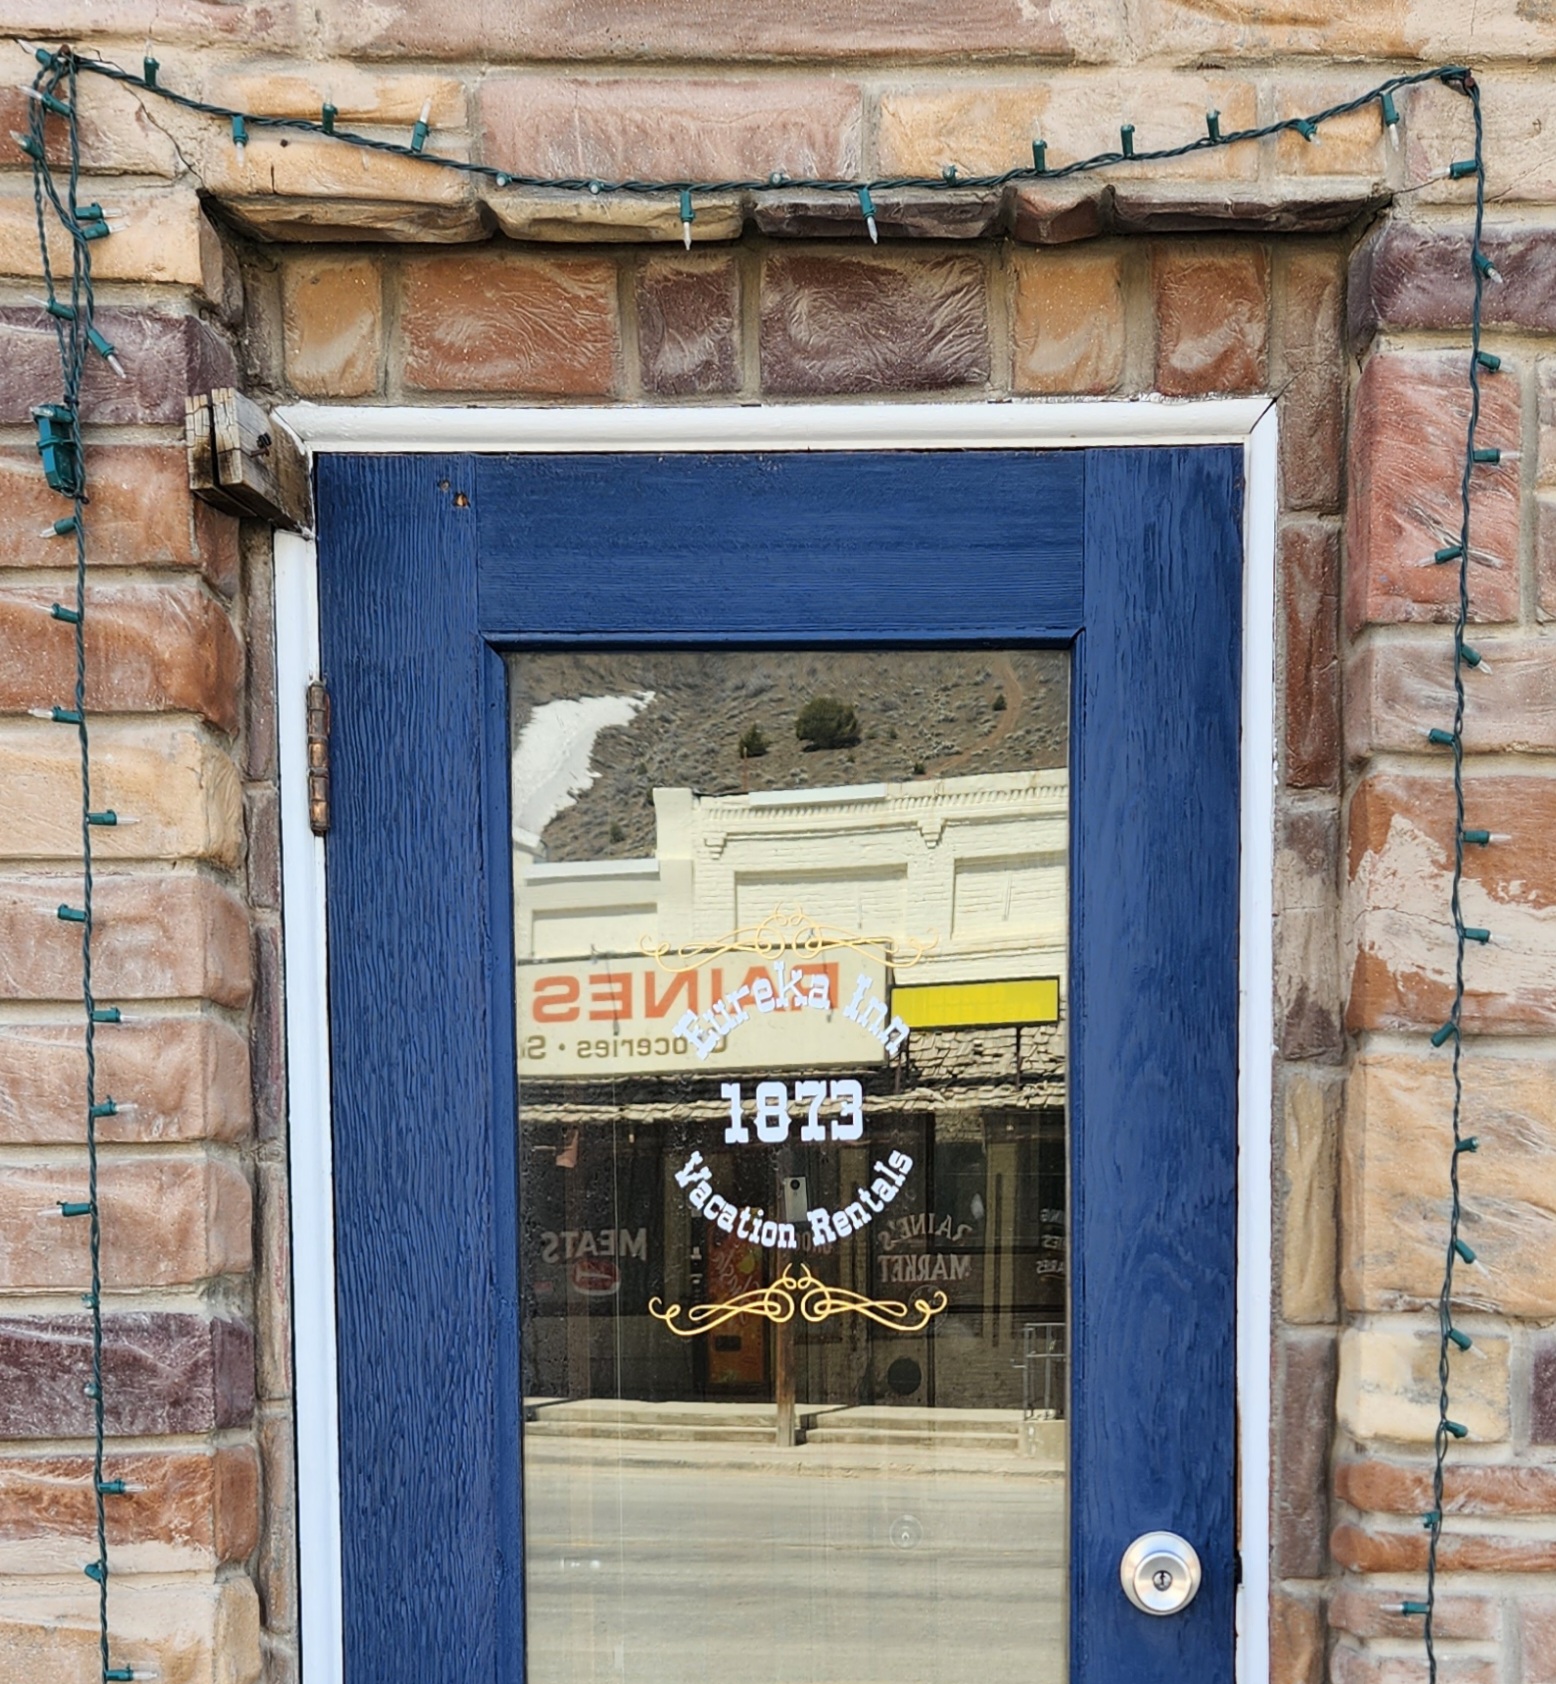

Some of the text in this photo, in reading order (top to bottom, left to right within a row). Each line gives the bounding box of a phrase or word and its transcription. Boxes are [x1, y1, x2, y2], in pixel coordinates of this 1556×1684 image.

[671, 961, 911, 1060] Eureka Inn
[721, 1079, 864, 1144] 1873
[675, 1149, 915, 1249] Vacation Rentals
